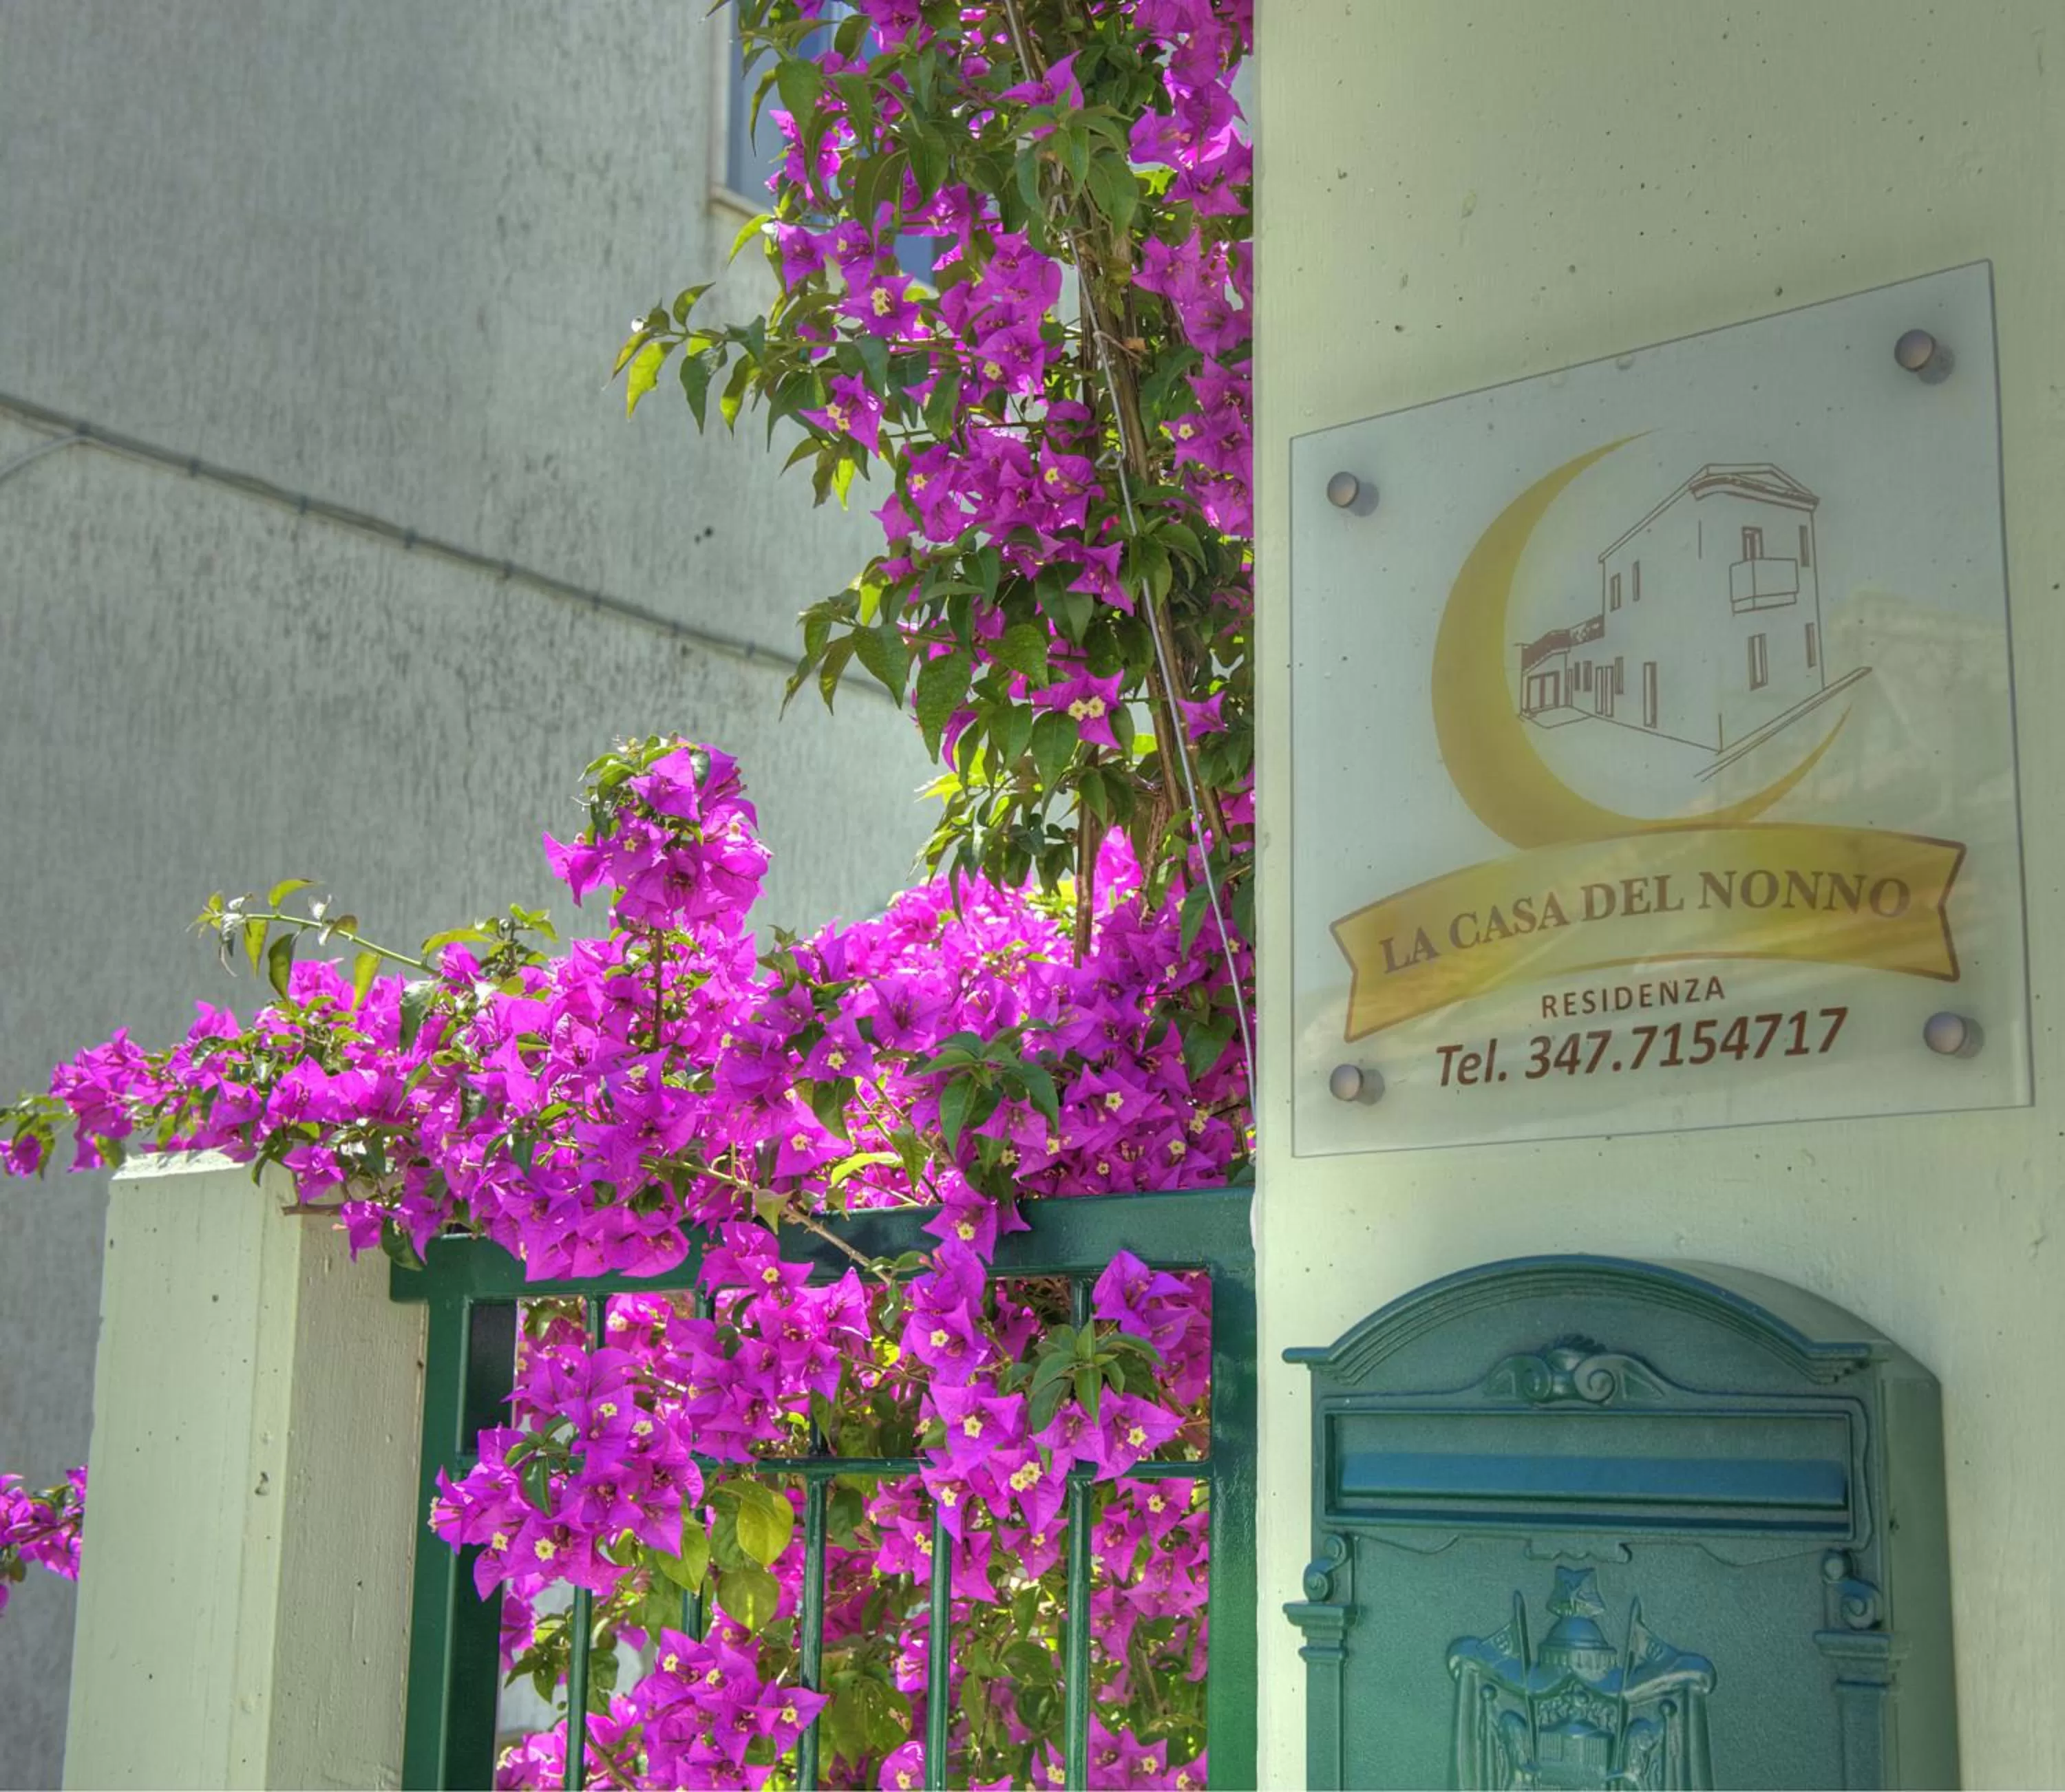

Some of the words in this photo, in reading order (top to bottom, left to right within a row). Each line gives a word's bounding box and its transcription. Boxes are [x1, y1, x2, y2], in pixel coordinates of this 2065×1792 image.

[1379, 928, 1439, 974] LA
[1449, 893, 1569, 950] CASA
[1580, 875, 1684, 922] DEL
[1698, 868, 1911, 919] NONNO
[1541, 975, 1726, 1019] RESIDENZA
[1436, 1037, 1507, 1087] Tel.
[1525, 1007, 1848, 1080] 347.7154717
